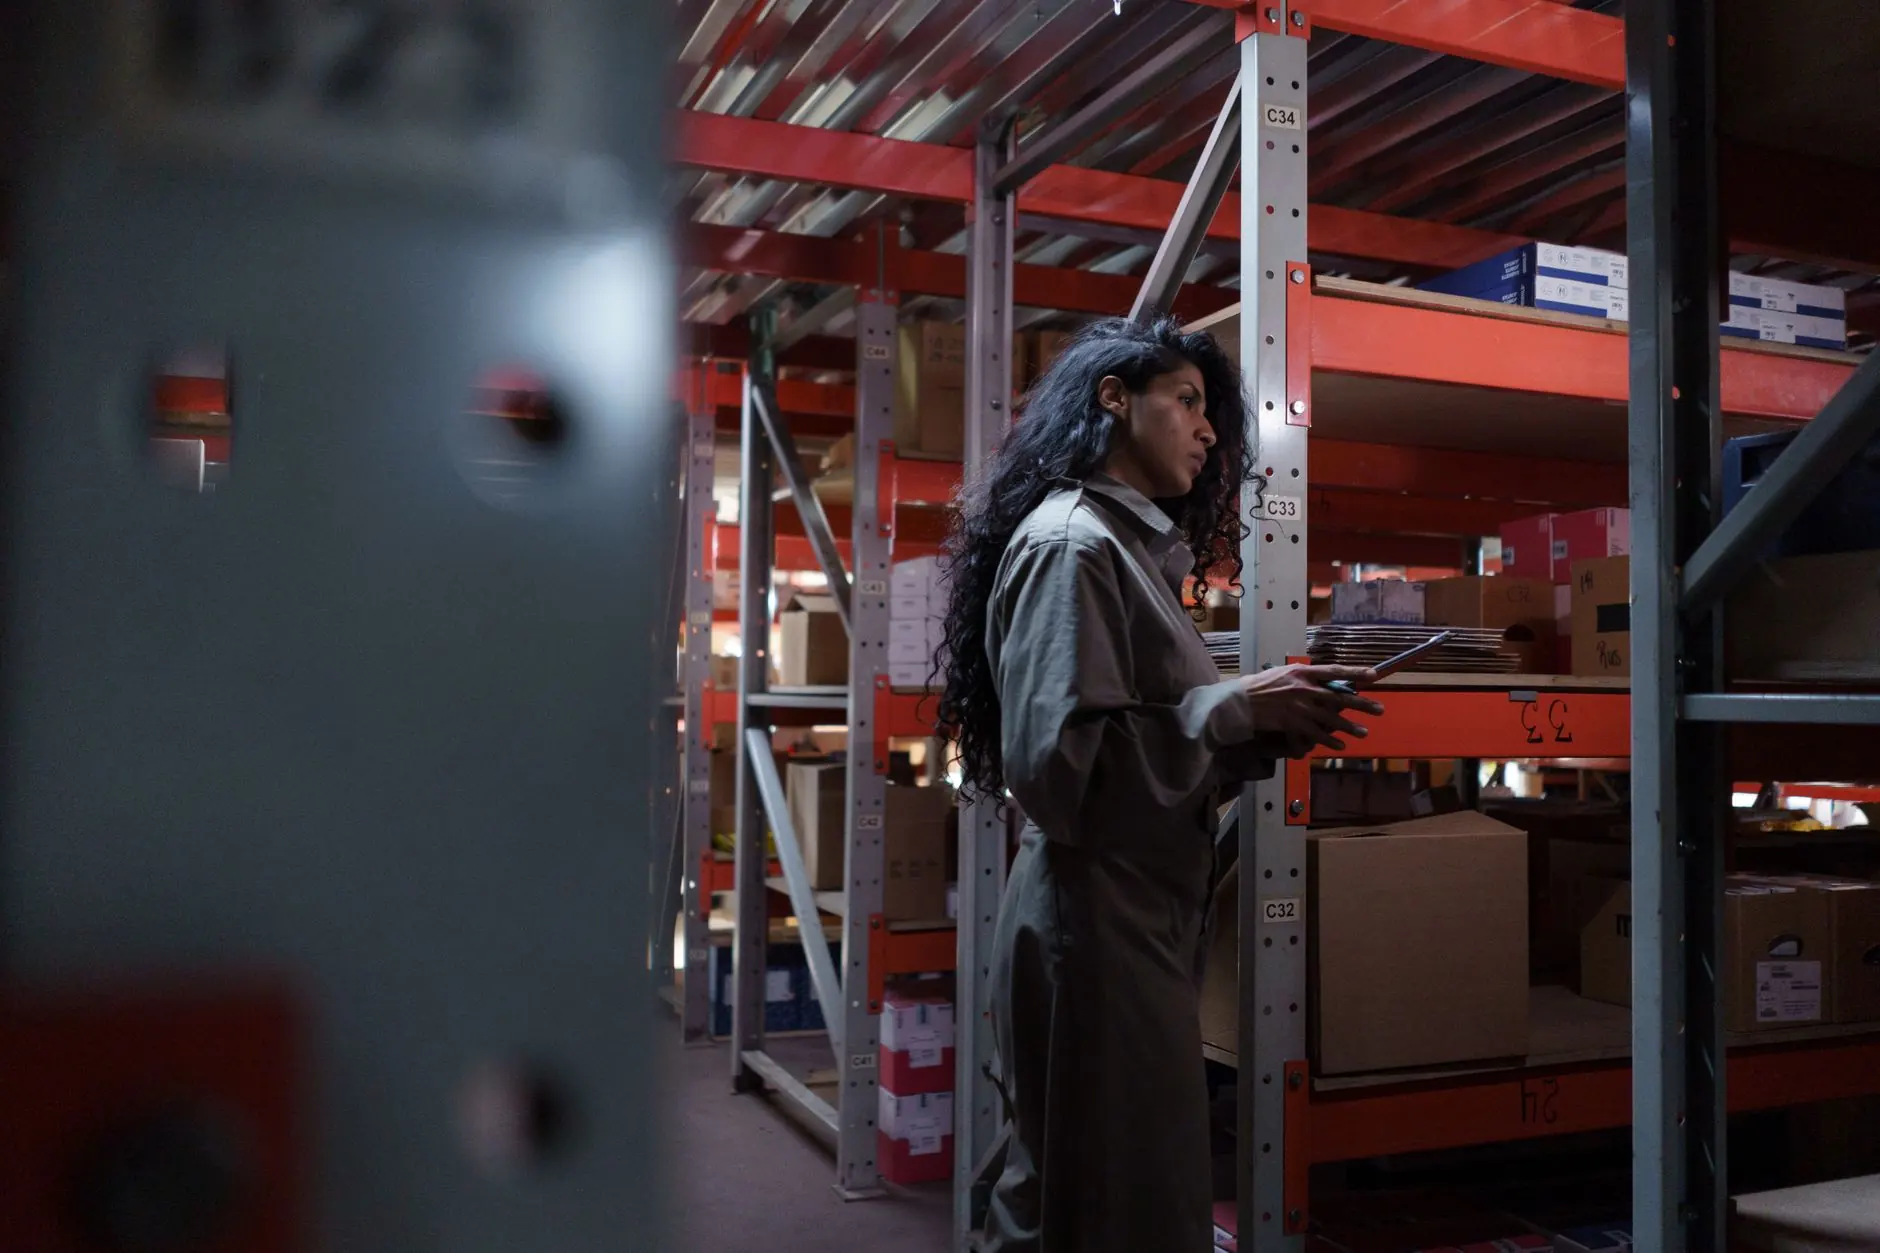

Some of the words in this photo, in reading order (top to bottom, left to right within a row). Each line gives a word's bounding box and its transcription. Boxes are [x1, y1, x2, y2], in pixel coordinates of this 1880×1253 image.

[1267, 108, 1296, 125] C34
[1267, 500, 1296, 516] C33
[1520, 698, 1573, 744] 33
[1266, 902, 1294, 918] C32
